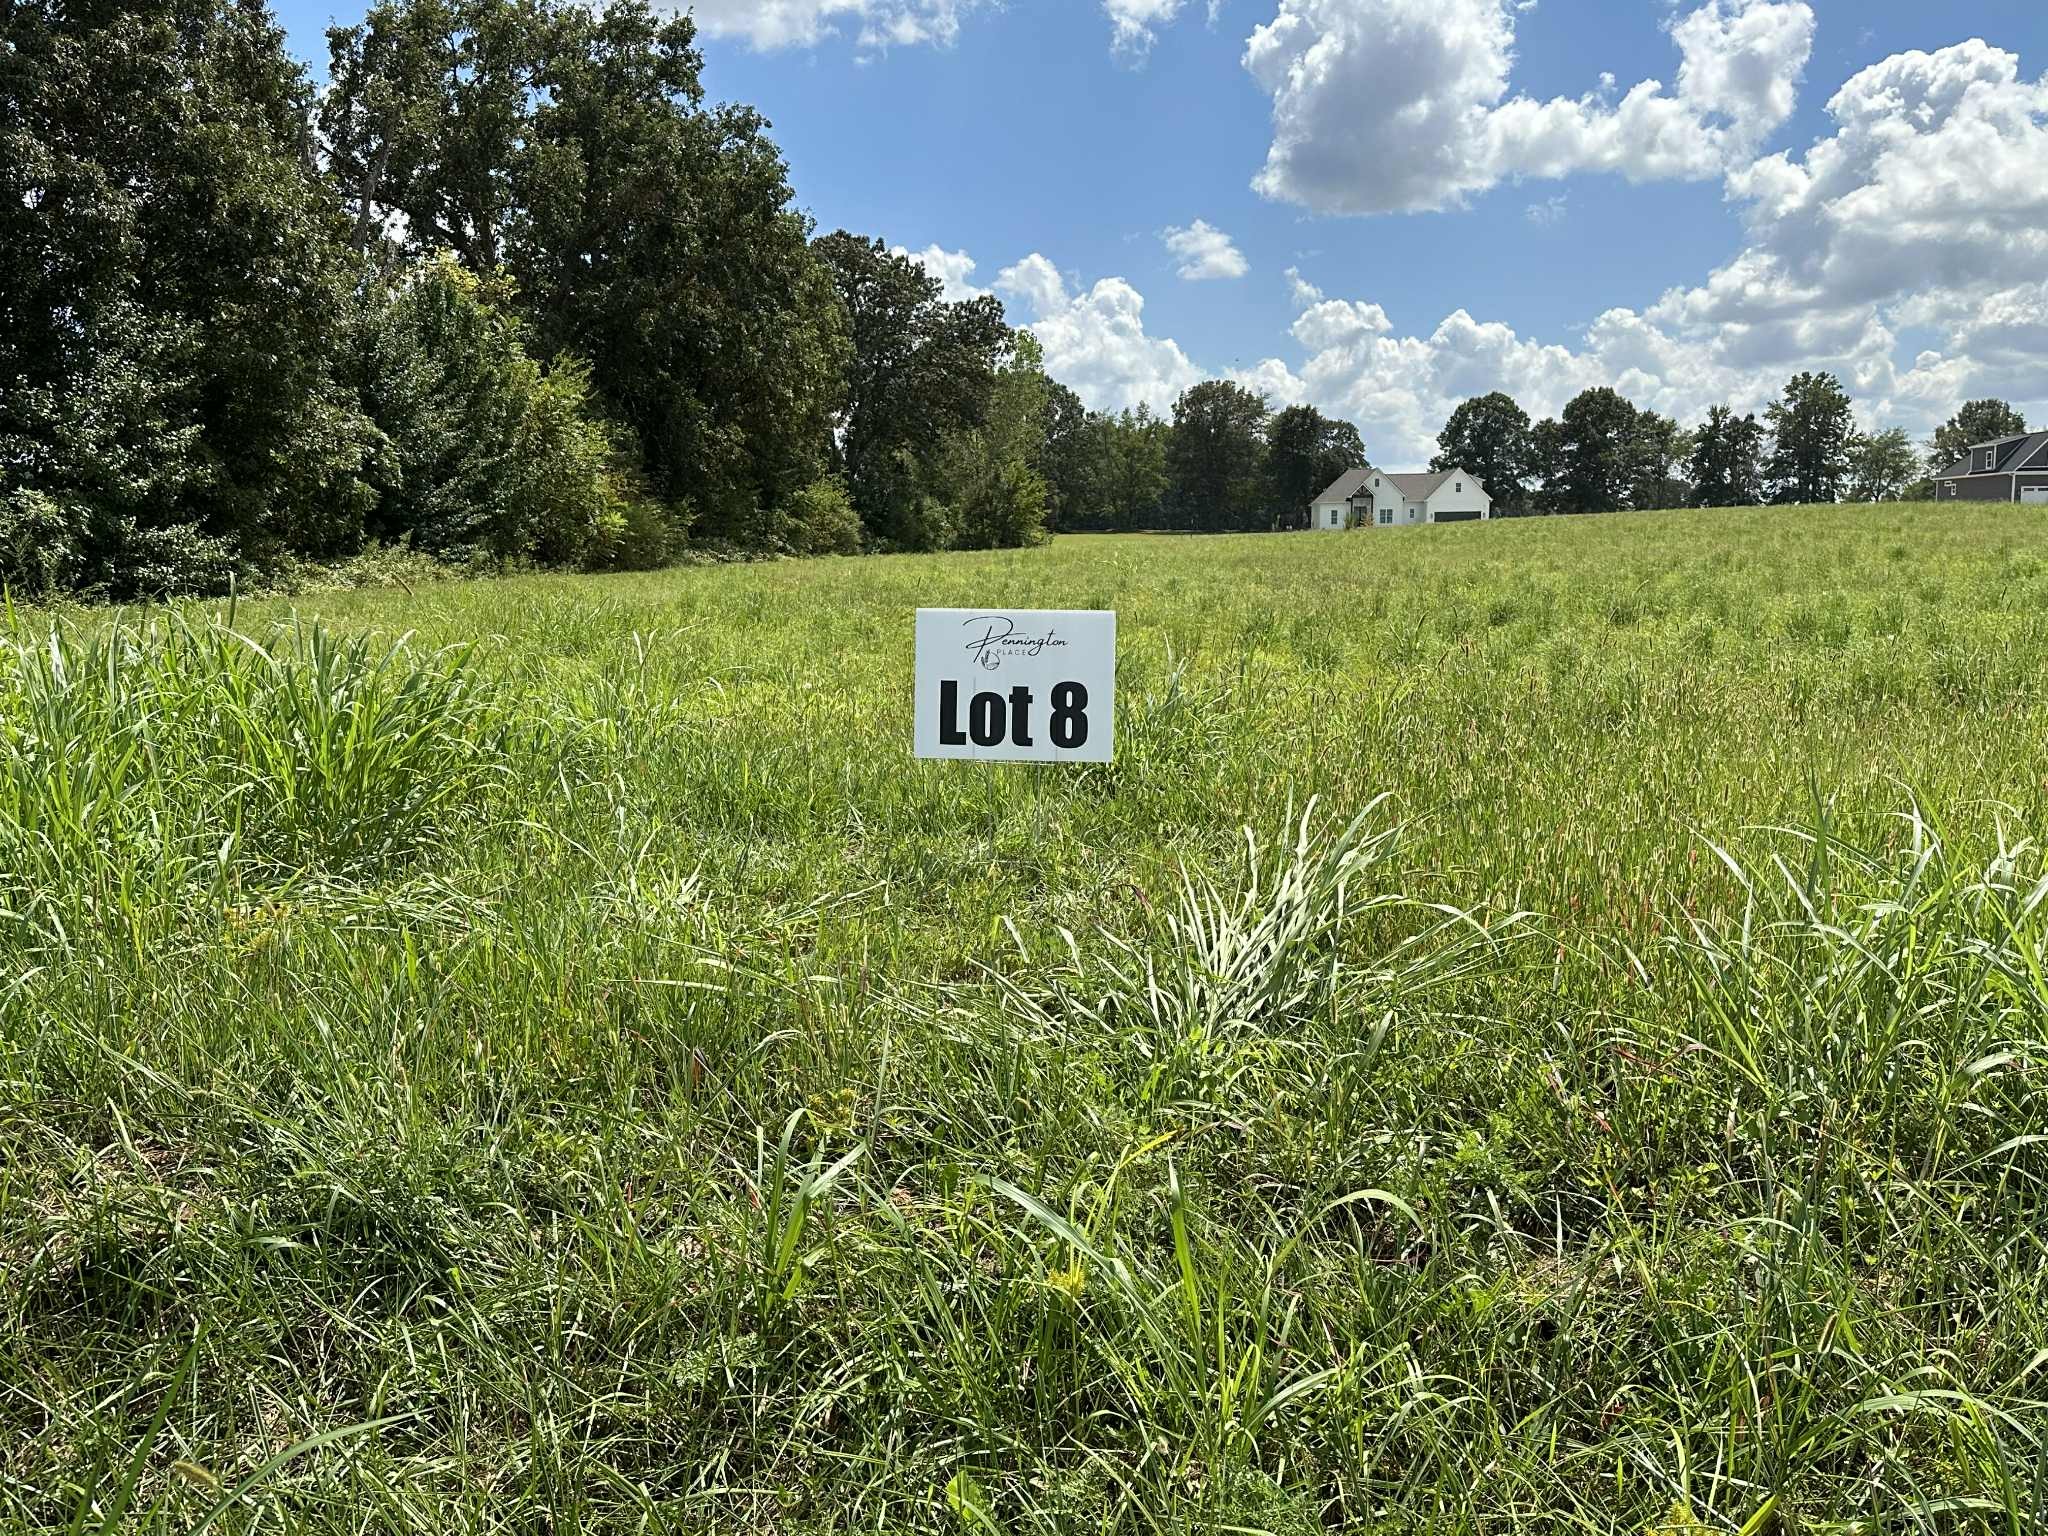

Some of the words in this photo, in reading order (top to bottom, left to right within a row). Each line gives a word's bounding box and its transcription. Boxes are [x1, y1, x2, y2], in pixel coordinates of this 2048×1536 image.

[962, 616, 1068, 663] Pennington
[939, 680, 1033, 747] Lot
[1049, 681, 1089, 749] 8
